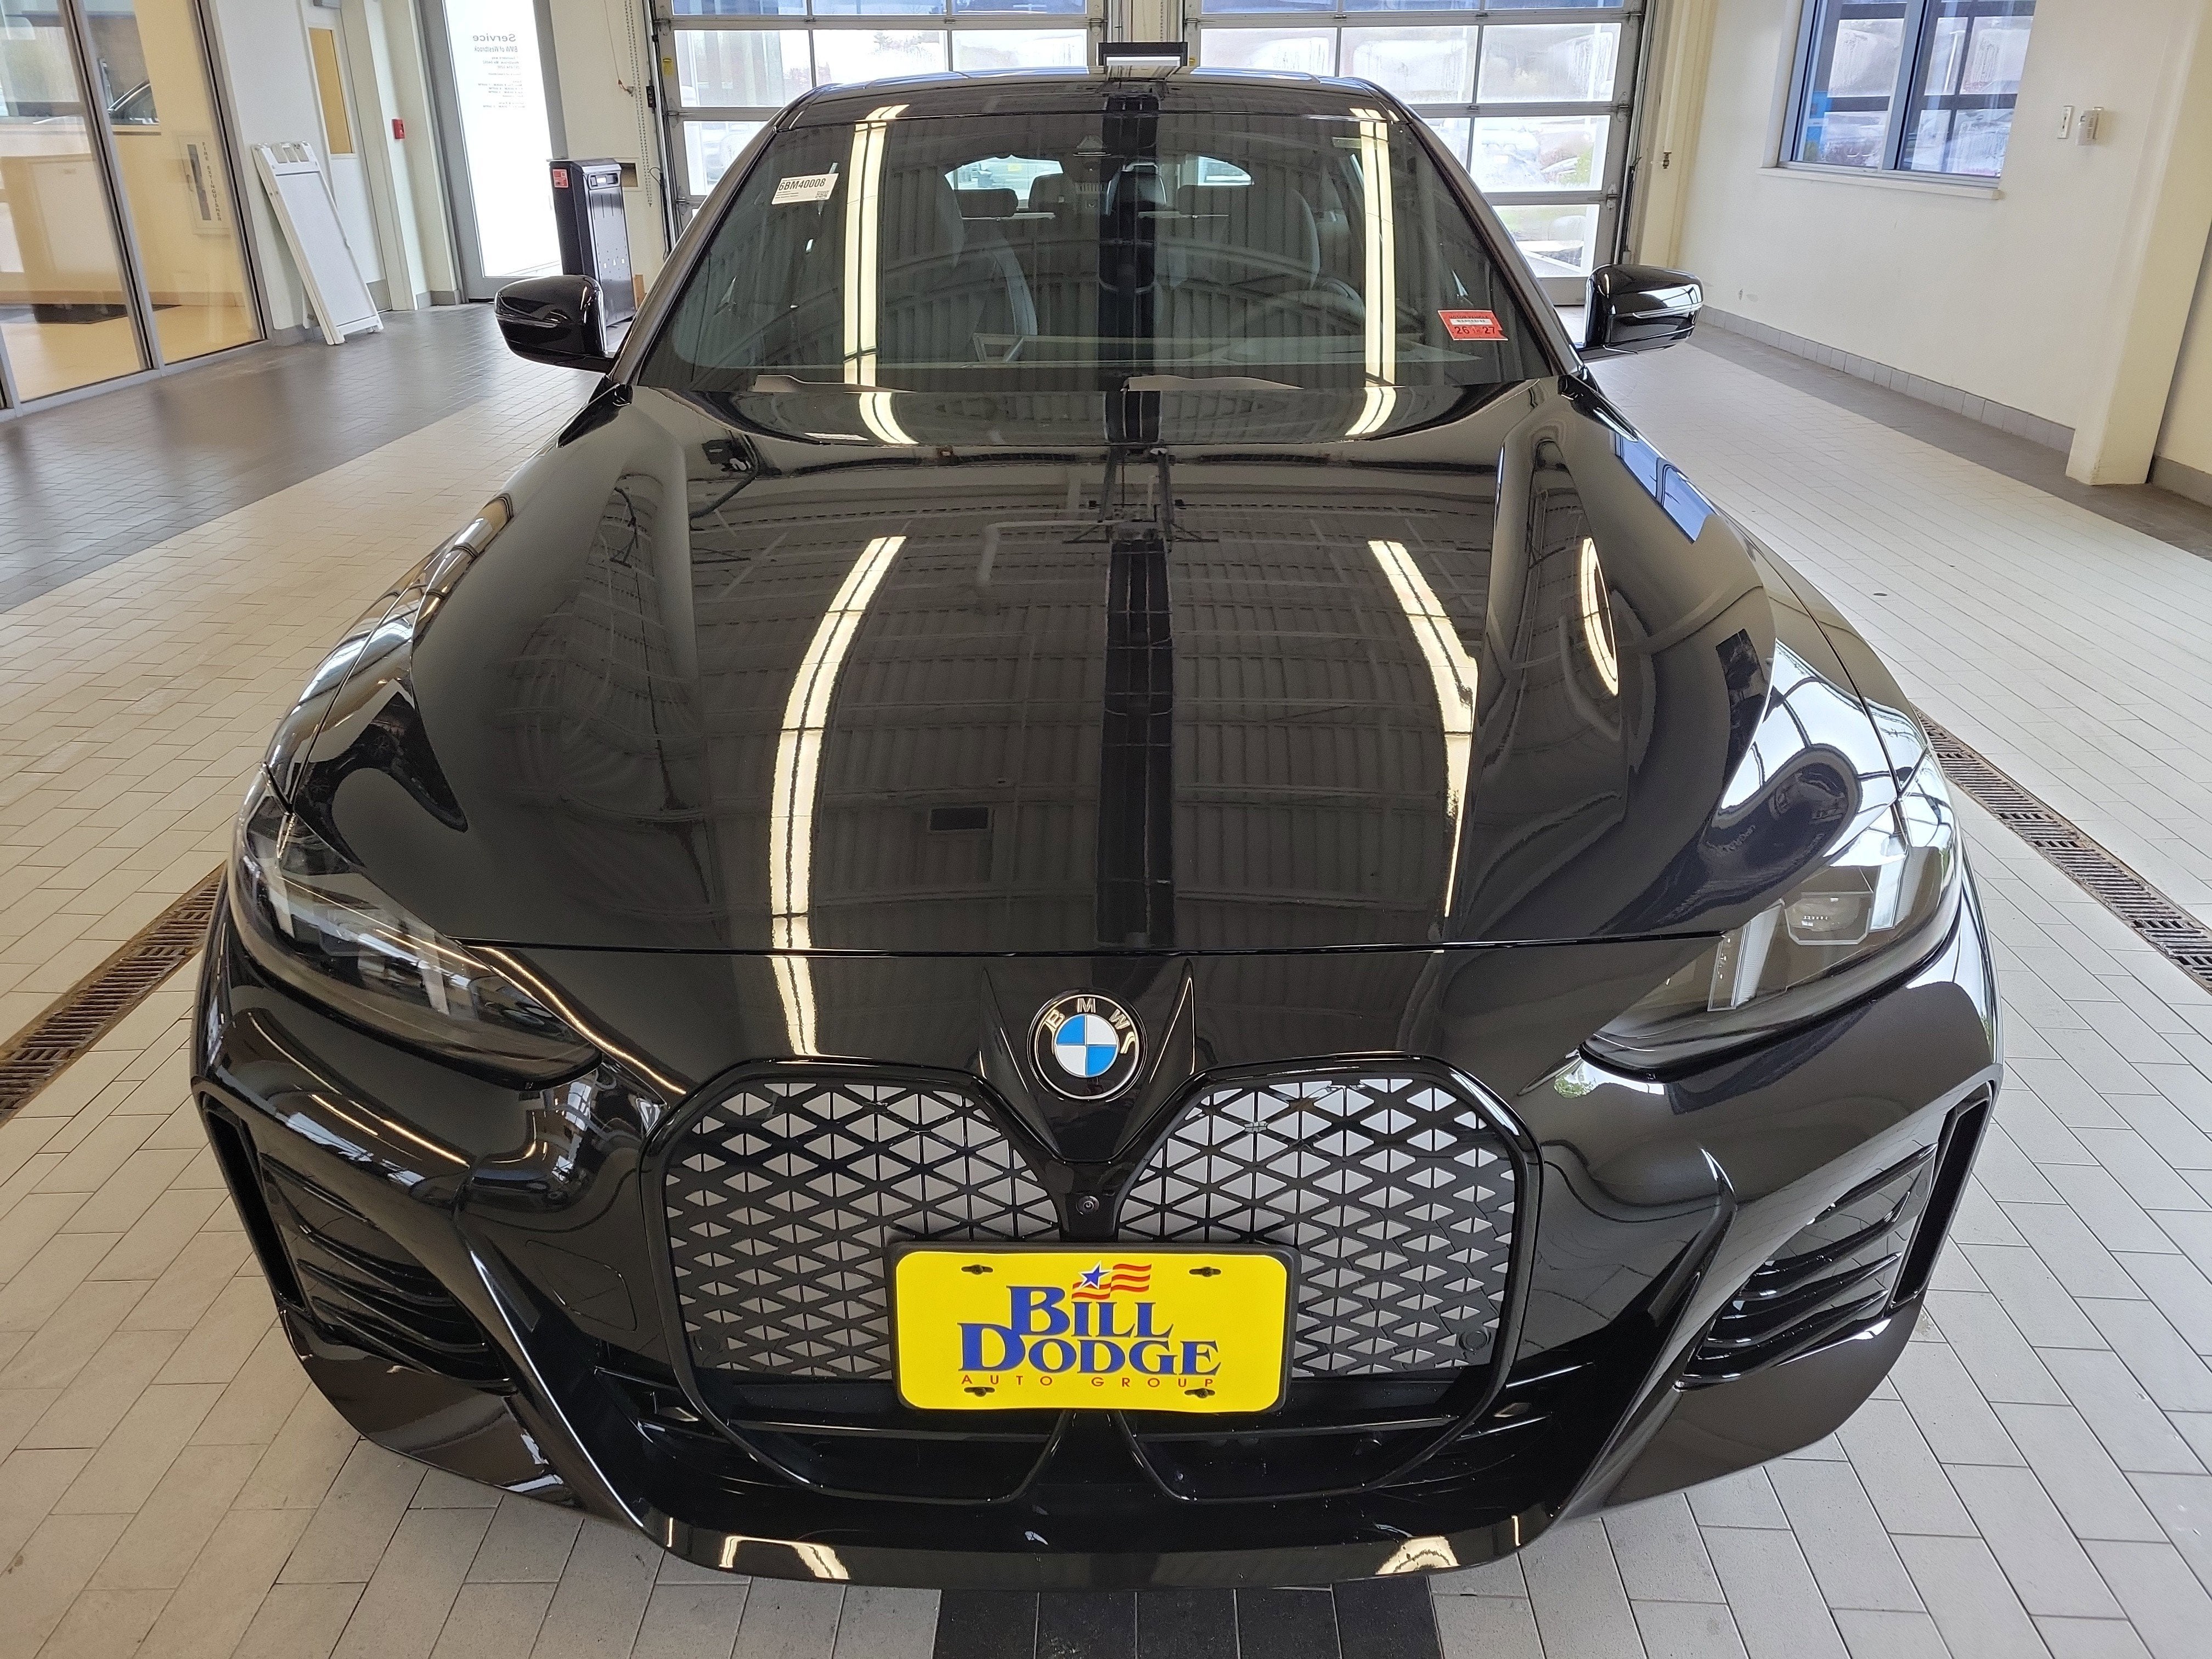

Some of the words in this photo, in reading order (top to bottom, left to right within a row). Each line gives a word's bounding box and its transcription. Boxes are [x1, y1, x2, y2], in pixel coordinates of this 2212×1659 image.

[207, 165, 222, 222] EXTINGUISHER
[778, 178, 826, 191] 6BM40008
[1454, 326, 1470, 334] 26
[1482, 326, 1495, 334] 27
[1045, 997, 1131, 1030] BMW
[1006, 1285, 1174, 1338] BILL
[957, 1322, 1221, 1375] DODGE
[961, 1374, 1053, 1387] AUTO
[1091, 1376, 1214, 1388] GROUP
